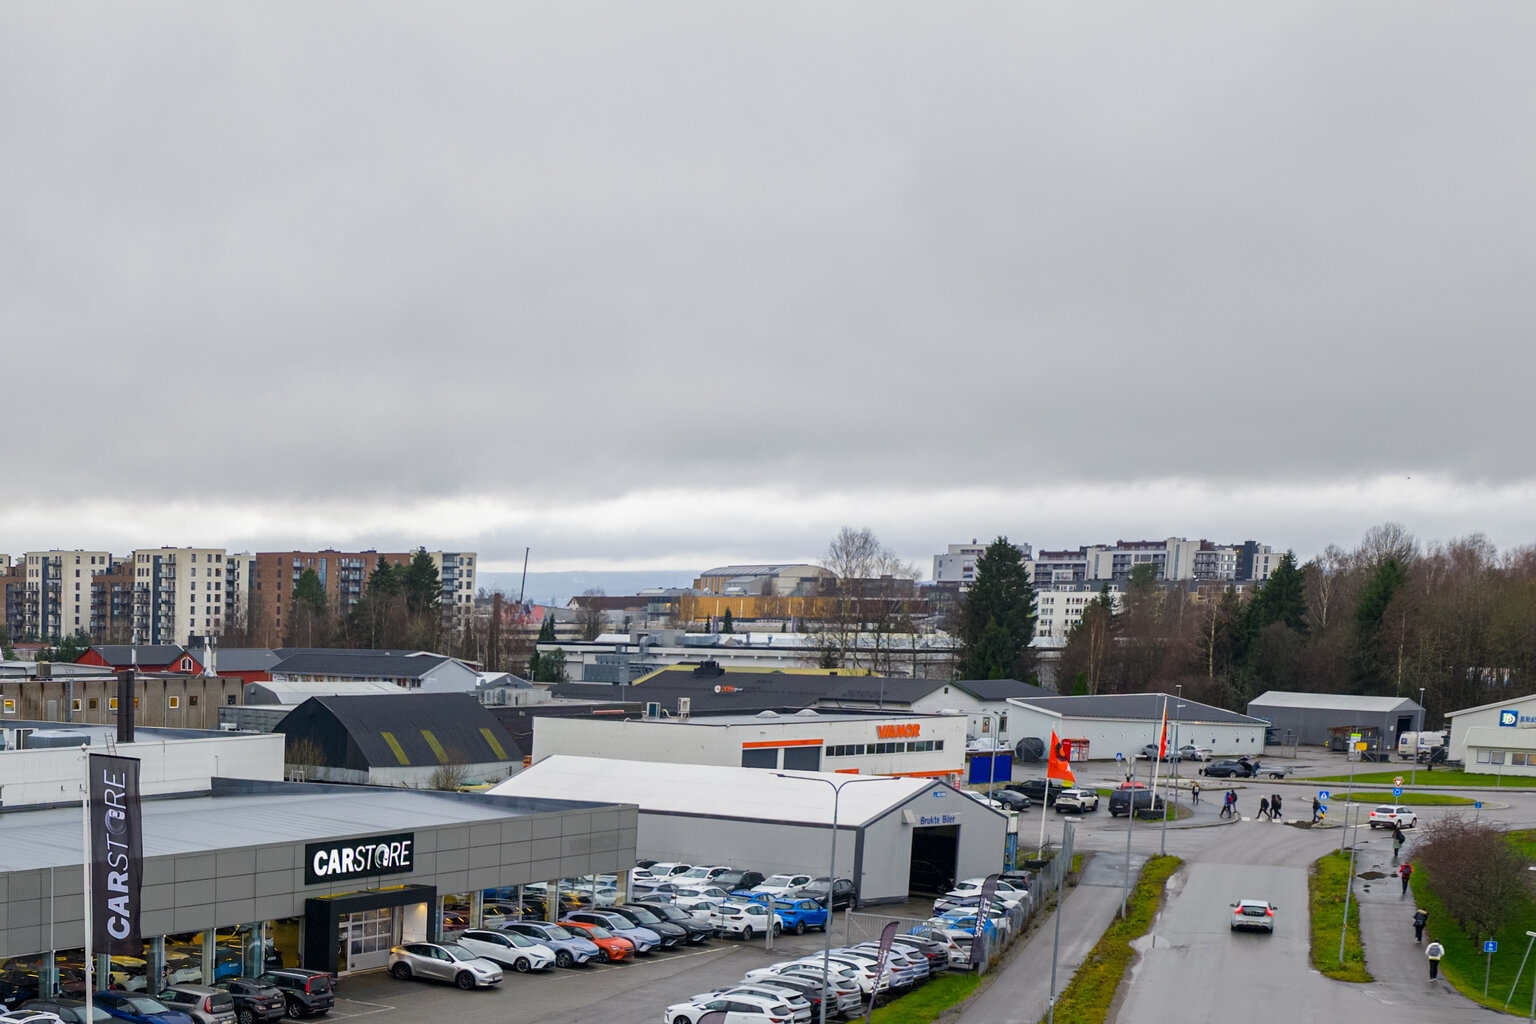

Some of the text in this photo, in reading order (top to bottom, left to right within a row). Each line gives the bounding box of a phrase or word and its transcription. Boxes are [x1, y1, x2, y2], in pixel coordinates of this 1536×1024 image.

[920, 815, 955, 825] Brukte Biler
[104, 769, 131, 940] CARSTORE
[313, 841, 412, 876] CARSTORE
